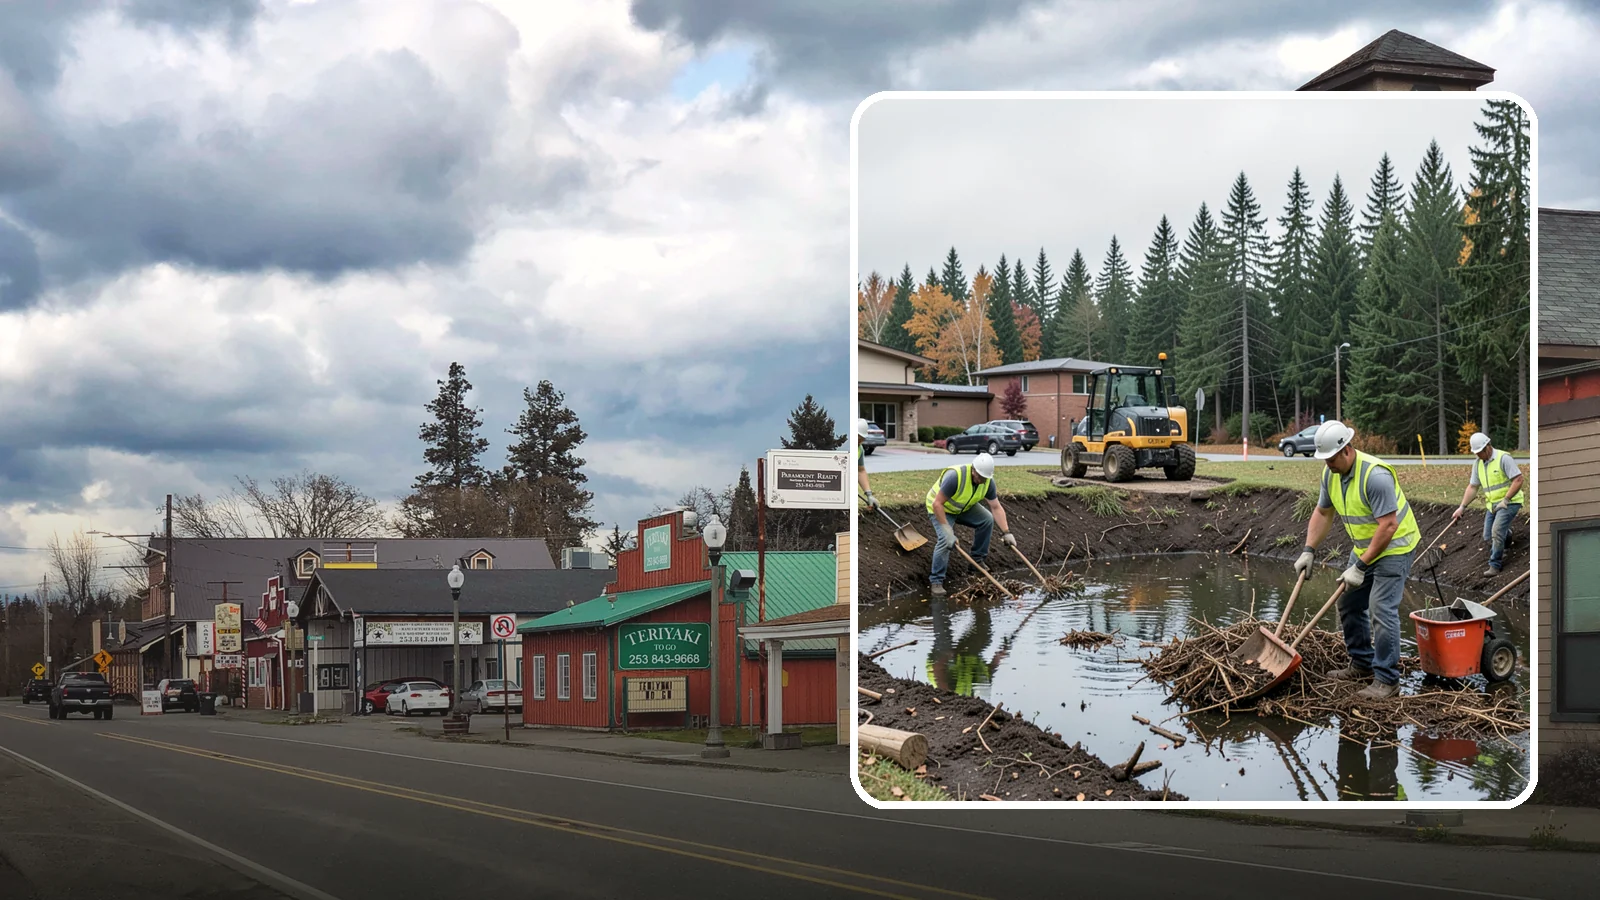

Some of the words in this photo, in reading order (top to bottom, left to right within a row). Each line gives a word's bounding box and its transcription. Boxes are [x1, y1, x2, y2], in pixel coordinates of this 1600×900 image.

[624, 627, 702, 646] TERIYAKI
[653, 643, 664, 651] TO
[665, 643, 677, 651] GO
[628, 654, 648, 665] 253
[651, 653, 700, 664] 843-9668
